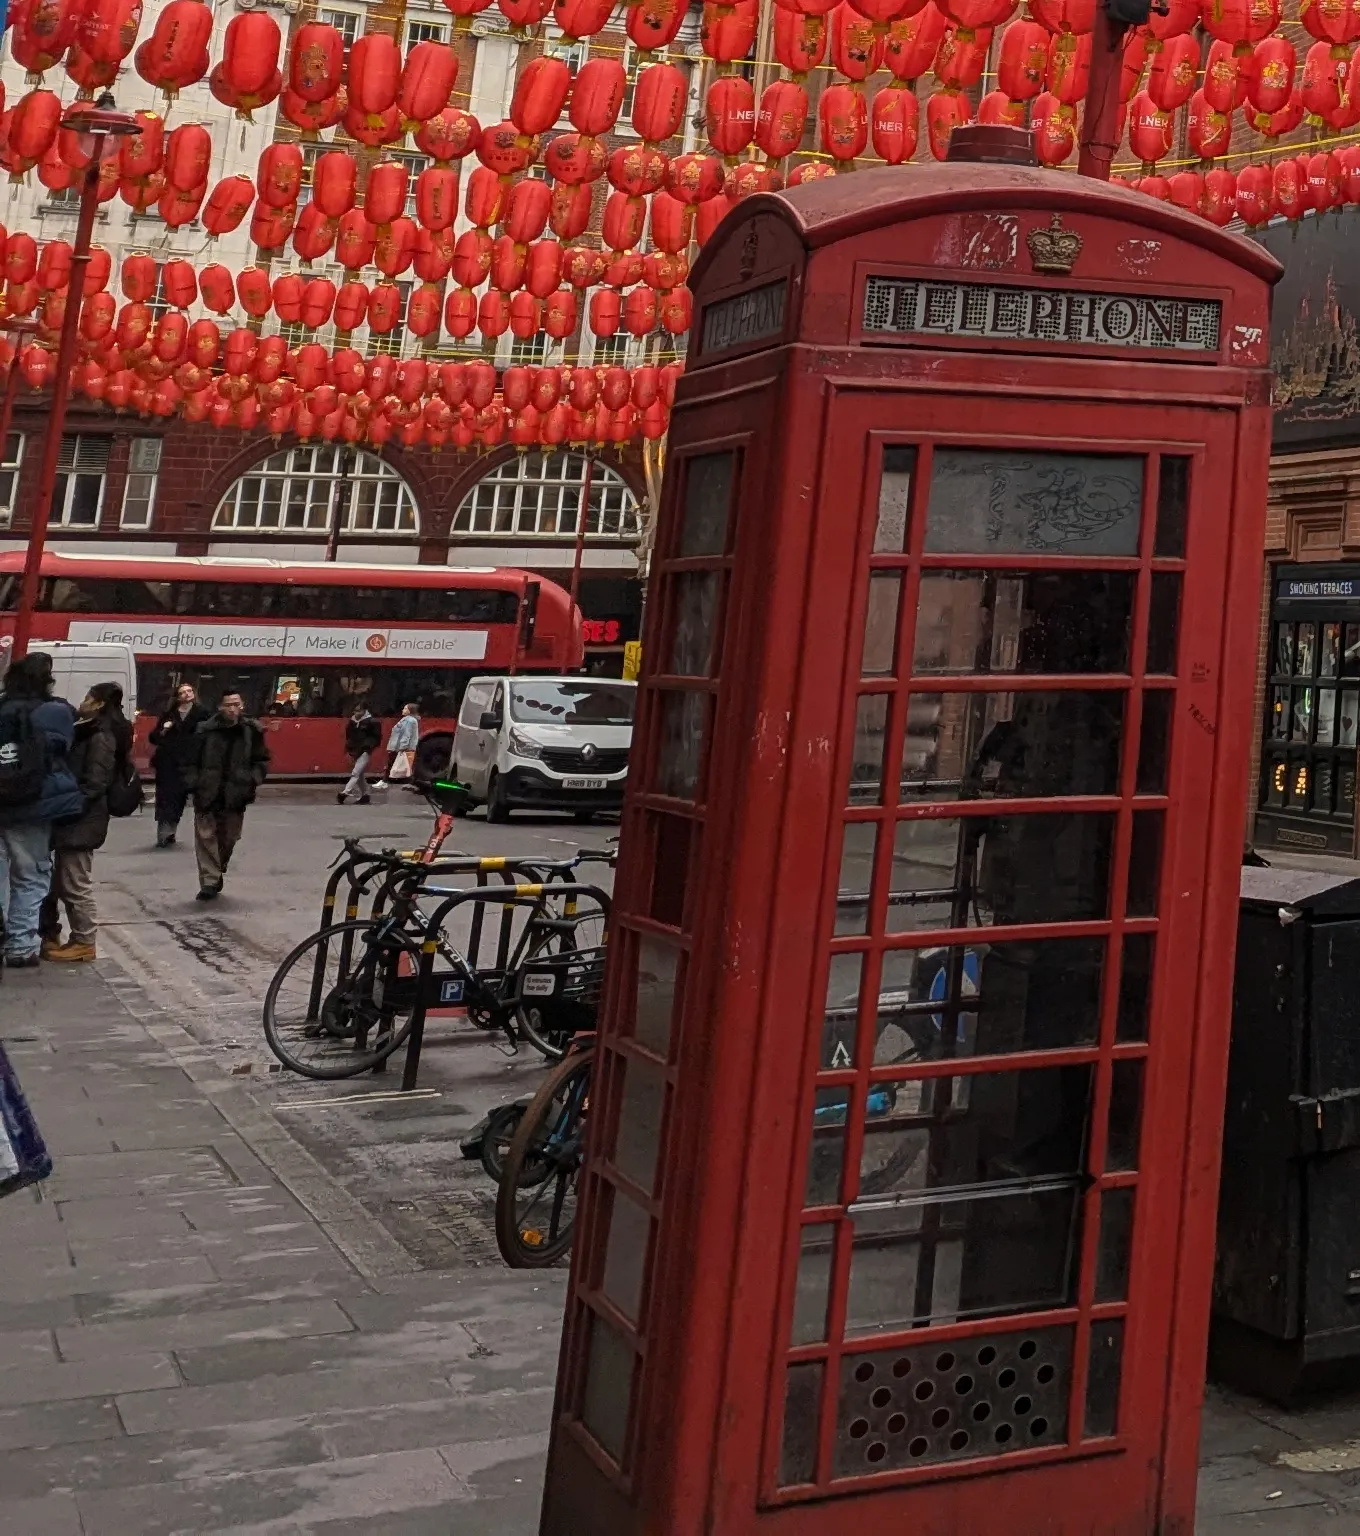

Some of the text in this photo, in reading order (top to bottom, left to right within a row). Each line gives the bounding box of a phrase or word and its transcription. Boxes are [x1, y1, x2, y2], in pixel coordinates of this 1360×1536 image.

[874, 120, 903, 133] LNER
[1138, 116, 1169, 128] LNER
[881, 285, 1205, 345] TELEPHONE
[1289, 581, 1353, 595] SMOKING TERRACES
[101, 631, 455, 651] Friend getting divorced? Make it amicable
